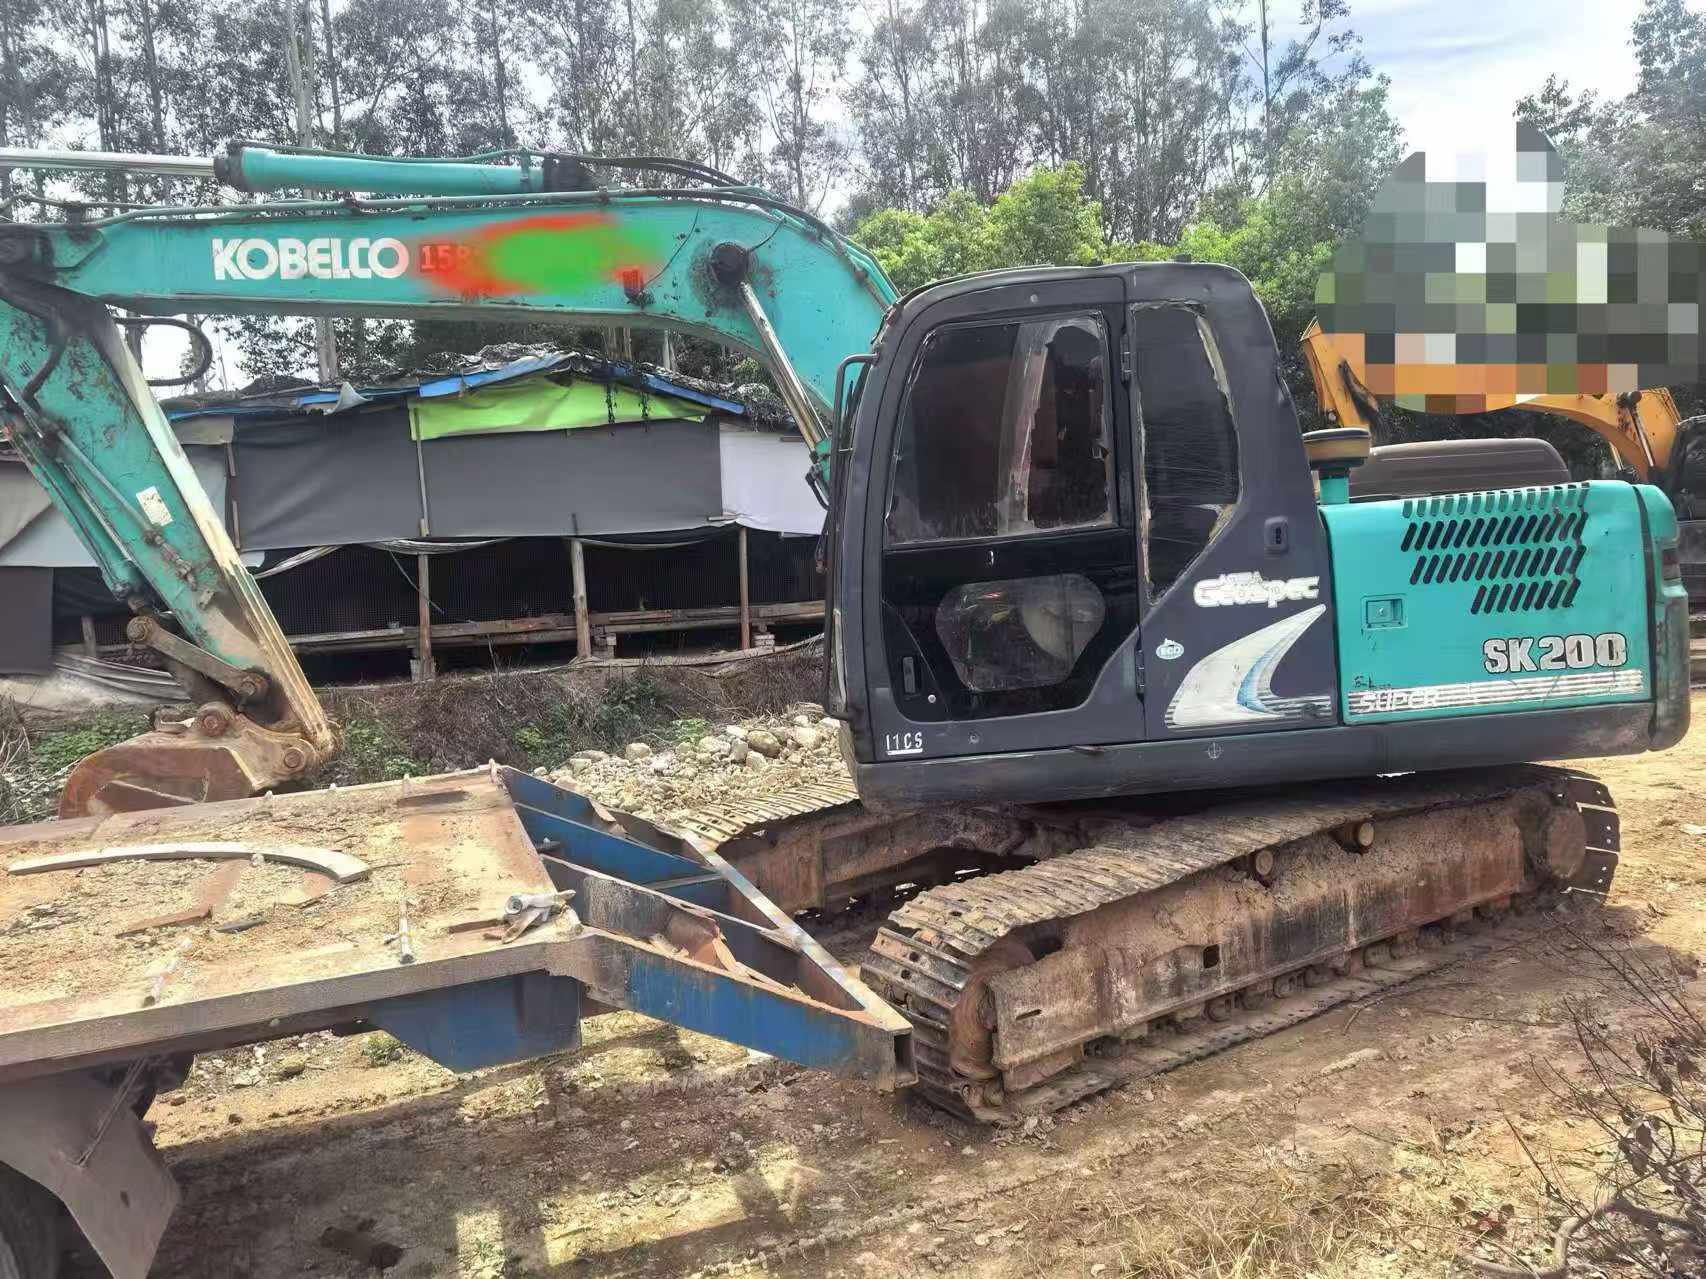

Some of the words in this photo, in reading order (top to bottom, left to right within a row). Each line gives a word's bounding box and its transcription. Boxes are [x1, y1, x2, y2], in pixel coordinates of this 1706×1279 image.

[211, 237, 410, 281] KOBELCO
[1482, 632, 1628, 673] SK200
[1358, 687, 1441, 711] SUPER
